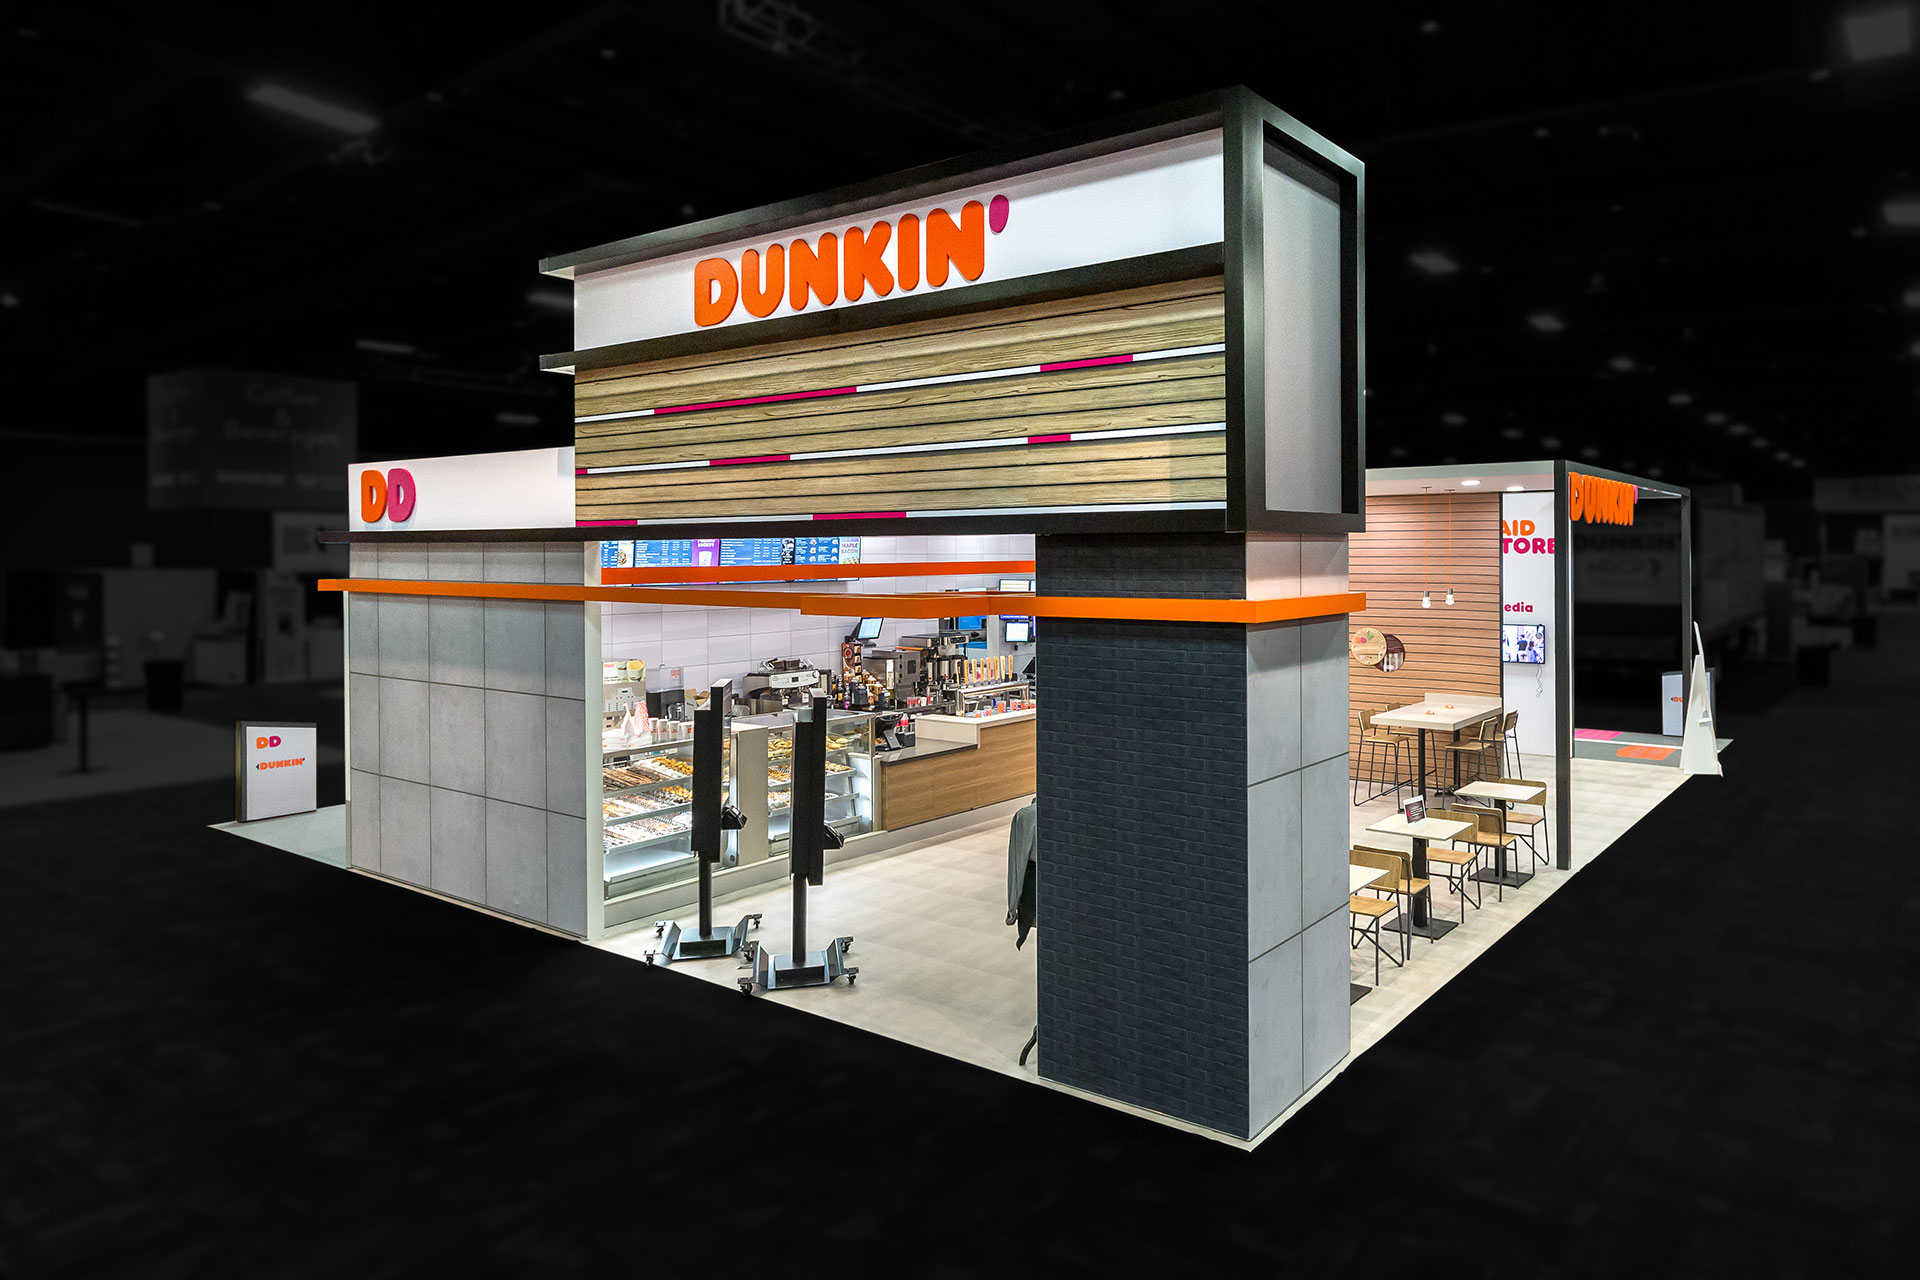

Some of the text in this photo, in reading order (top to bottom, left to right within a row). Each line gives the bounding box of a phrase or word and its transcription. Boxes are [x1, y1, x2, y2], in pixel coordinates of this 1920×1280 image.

[694, 194, 1010, 327] DUNKIN'
[361, 468, 416, 523] DD
[1568, 472, 1638, 526] DUNKIN'
[256, 735, 282, 749] DD
[260, 757, 305, 770] DUNKIN'
